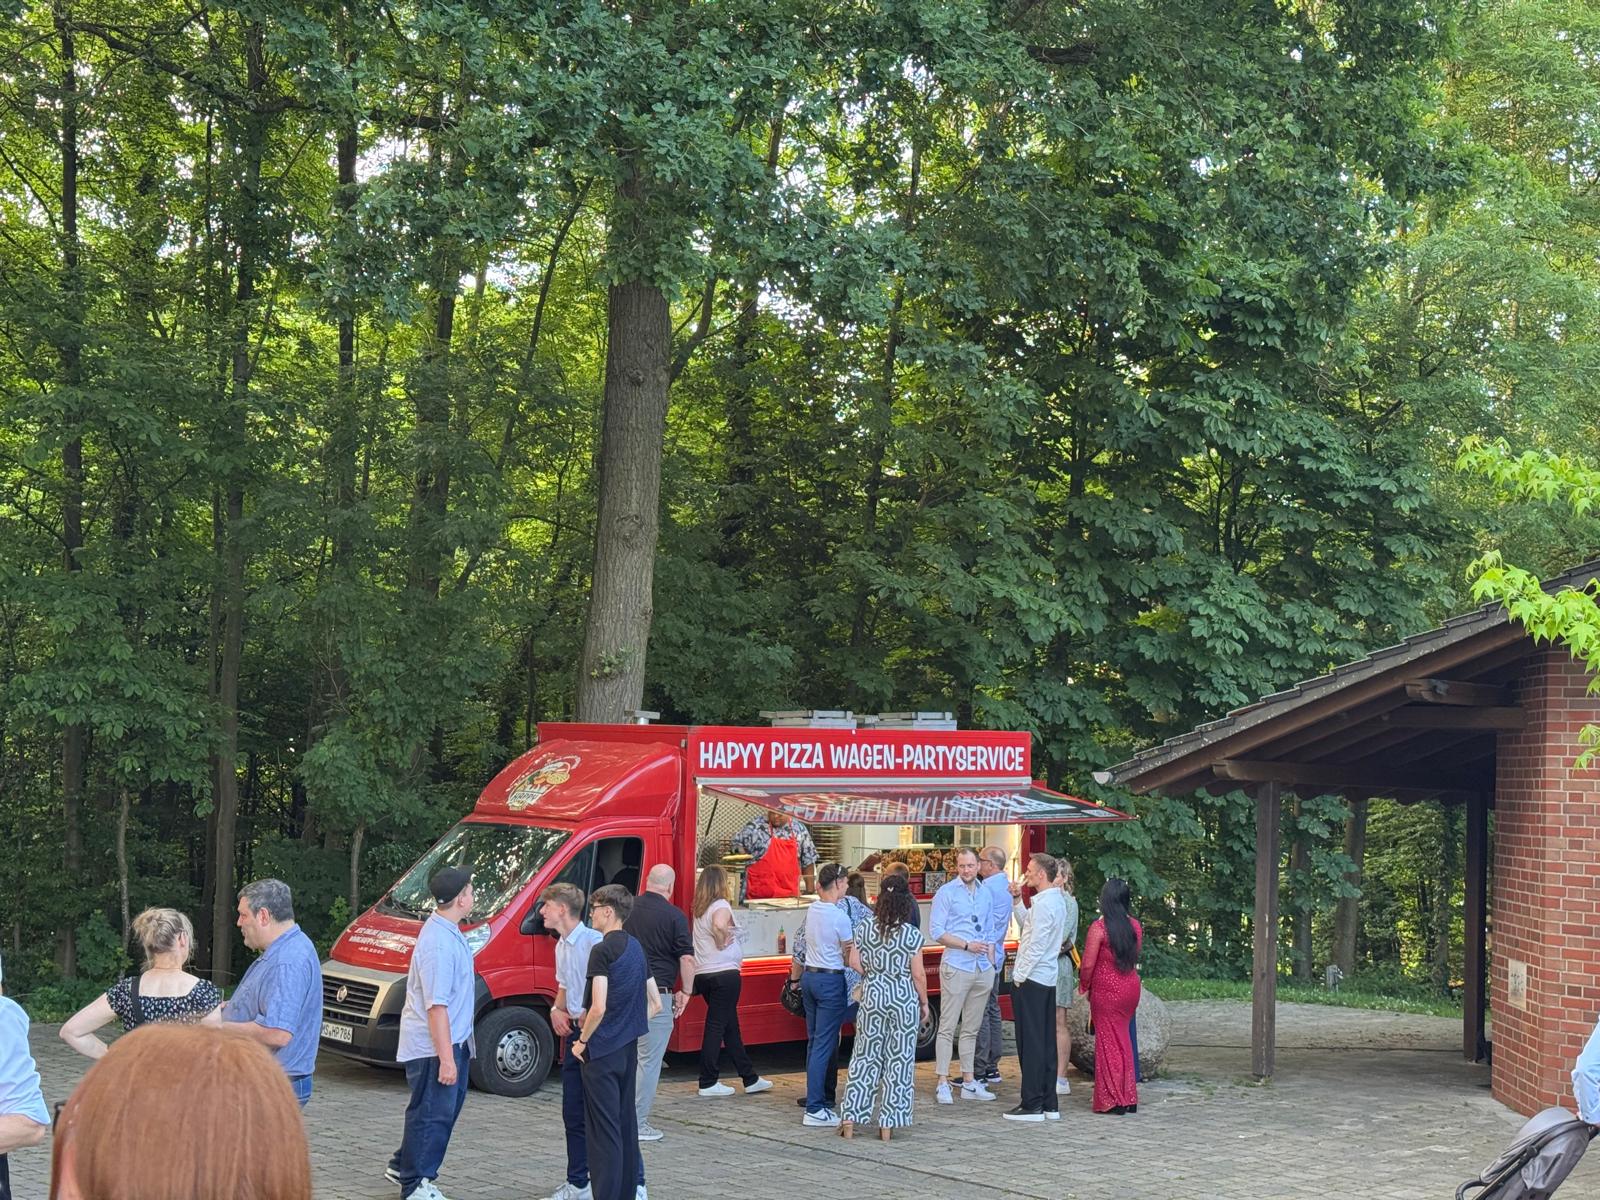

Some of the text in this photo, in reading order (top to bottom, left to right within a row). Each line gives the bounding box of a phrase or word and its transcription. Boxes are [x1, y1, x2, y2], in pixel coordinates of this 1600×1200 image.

[699, 741, 1025, 771] HAPYY PIZZA WAGEN-PARTYSERVICE
